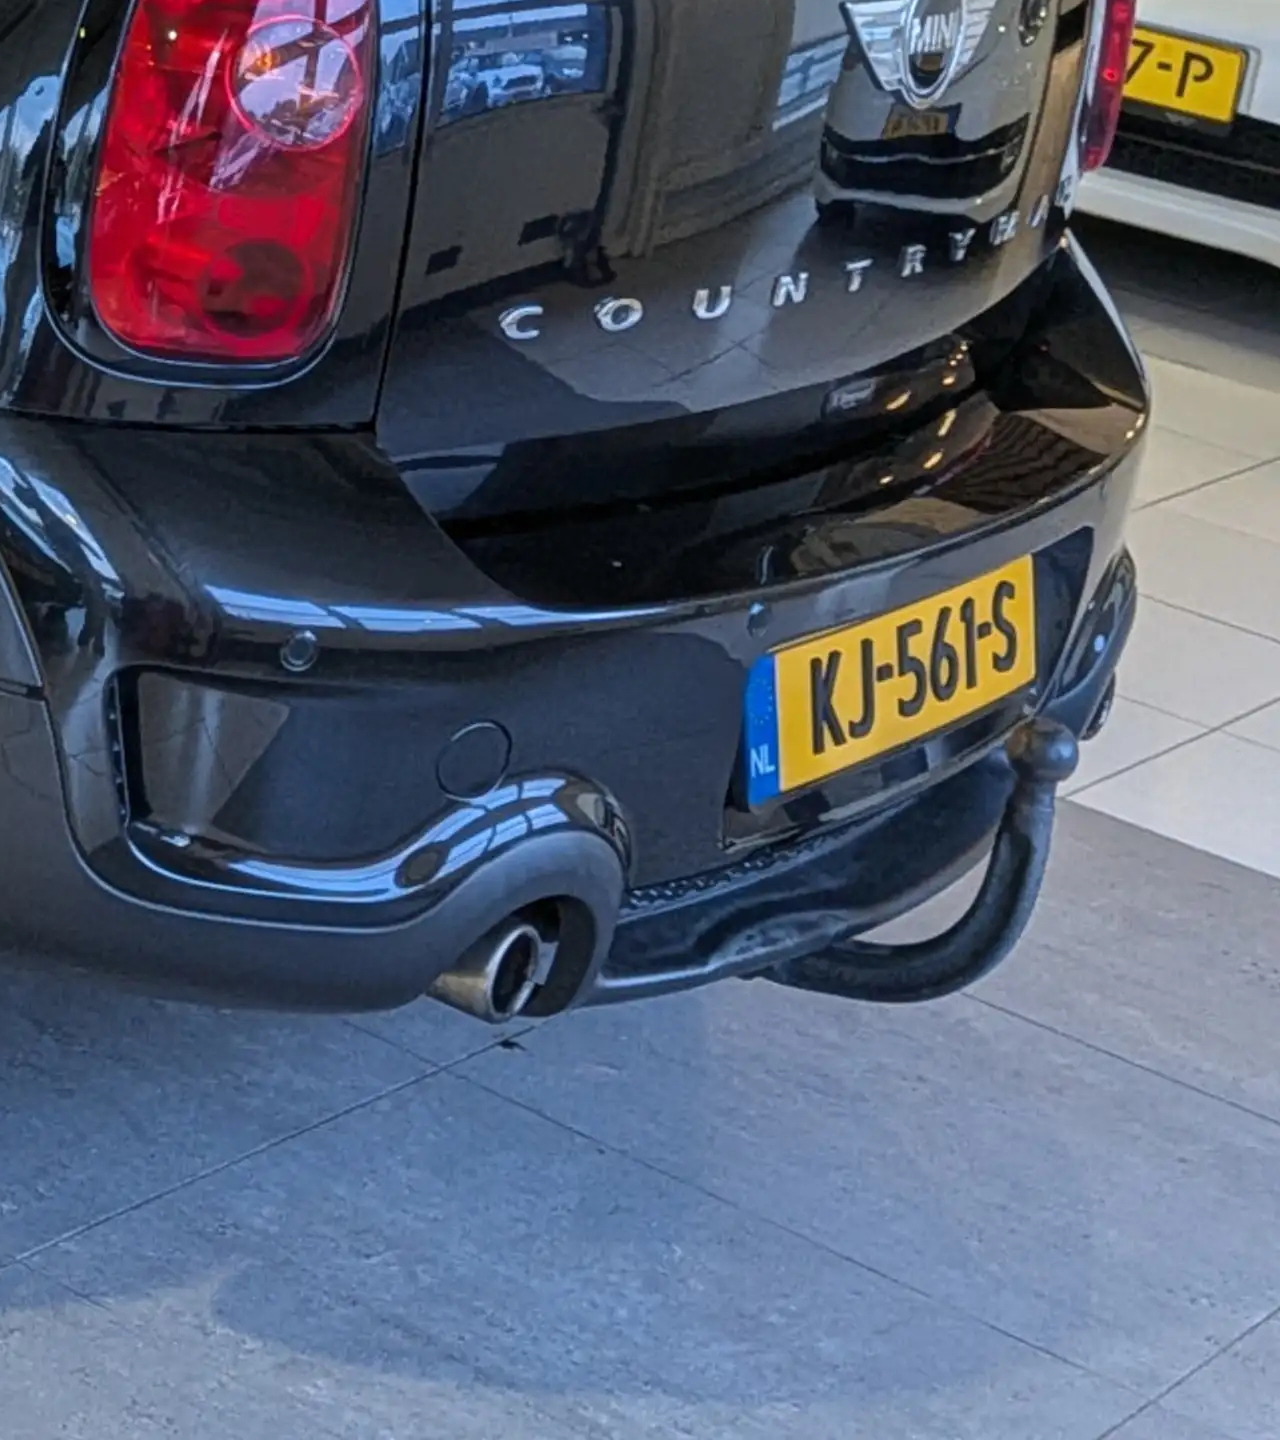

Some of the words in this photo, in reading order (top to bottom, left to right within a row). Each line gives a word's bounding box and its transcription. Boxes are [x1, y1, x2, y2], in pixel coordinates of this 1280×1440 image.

[910, 10, 960, 54] MINI
[809, 579, 1018, 756] KJ-561-S
[750, 743, 776, 778] NL
